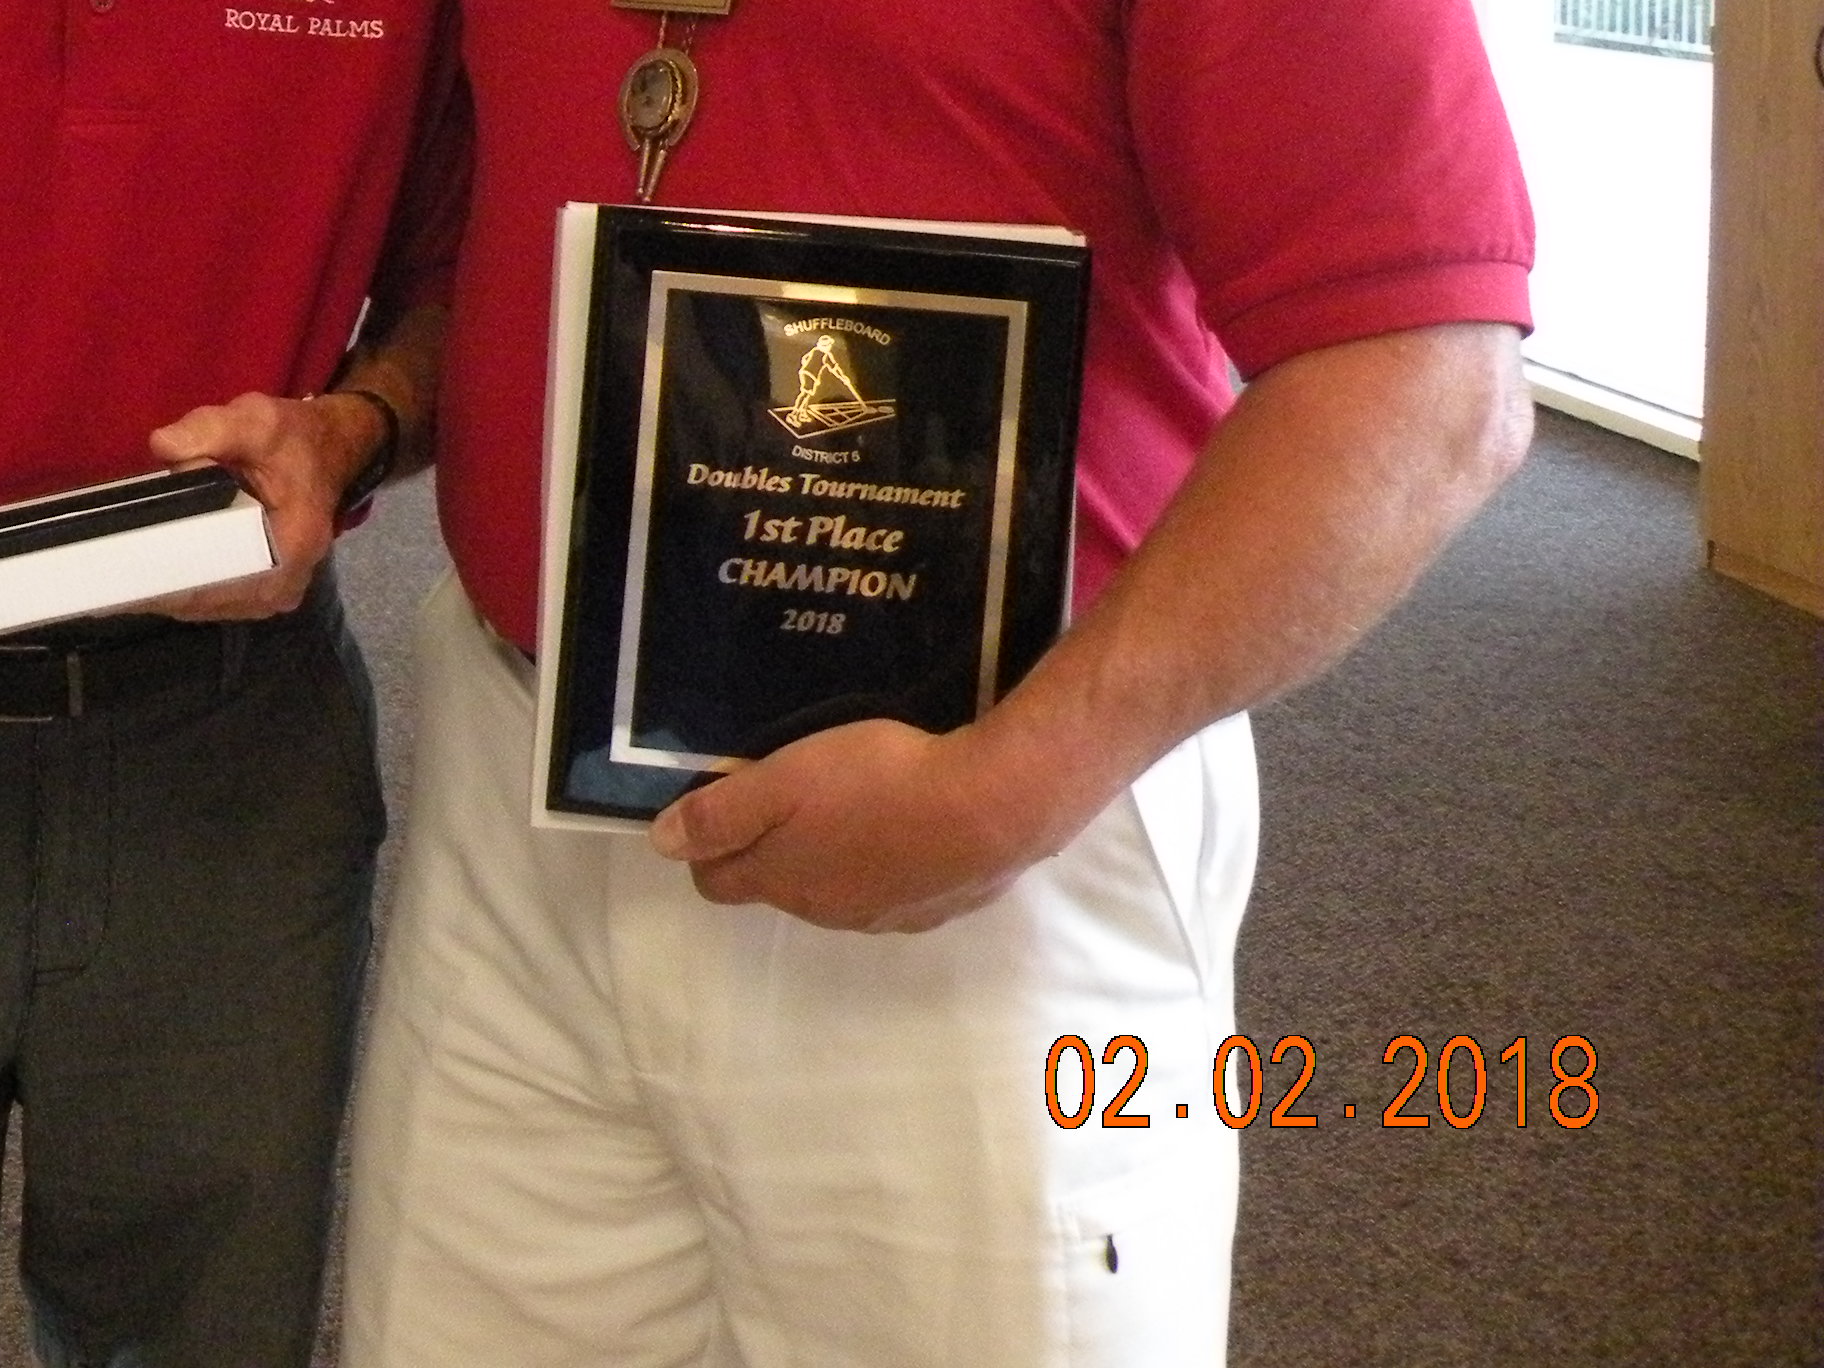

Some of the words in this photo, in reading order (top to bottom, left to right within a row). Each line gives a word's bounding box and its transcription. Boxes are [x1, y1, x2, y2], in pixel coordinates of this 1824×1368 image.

[225, 8, 300, 33] ROYAL
[307, 17, 384, 39] PALMS
[783, 317, 891, 346] SHUFFLEBOARD
[791, 444, 849, 464] DISTRICT
[687, 463, 793, 493] Doubles
[800, 473, 966, 509] Tournament
[743, 509, 803, 544] 1st
[805, 514, 904, 553] Place
[718, 557, 917, 601] CHAMPION
[780, 608, 847, 635] 2018
